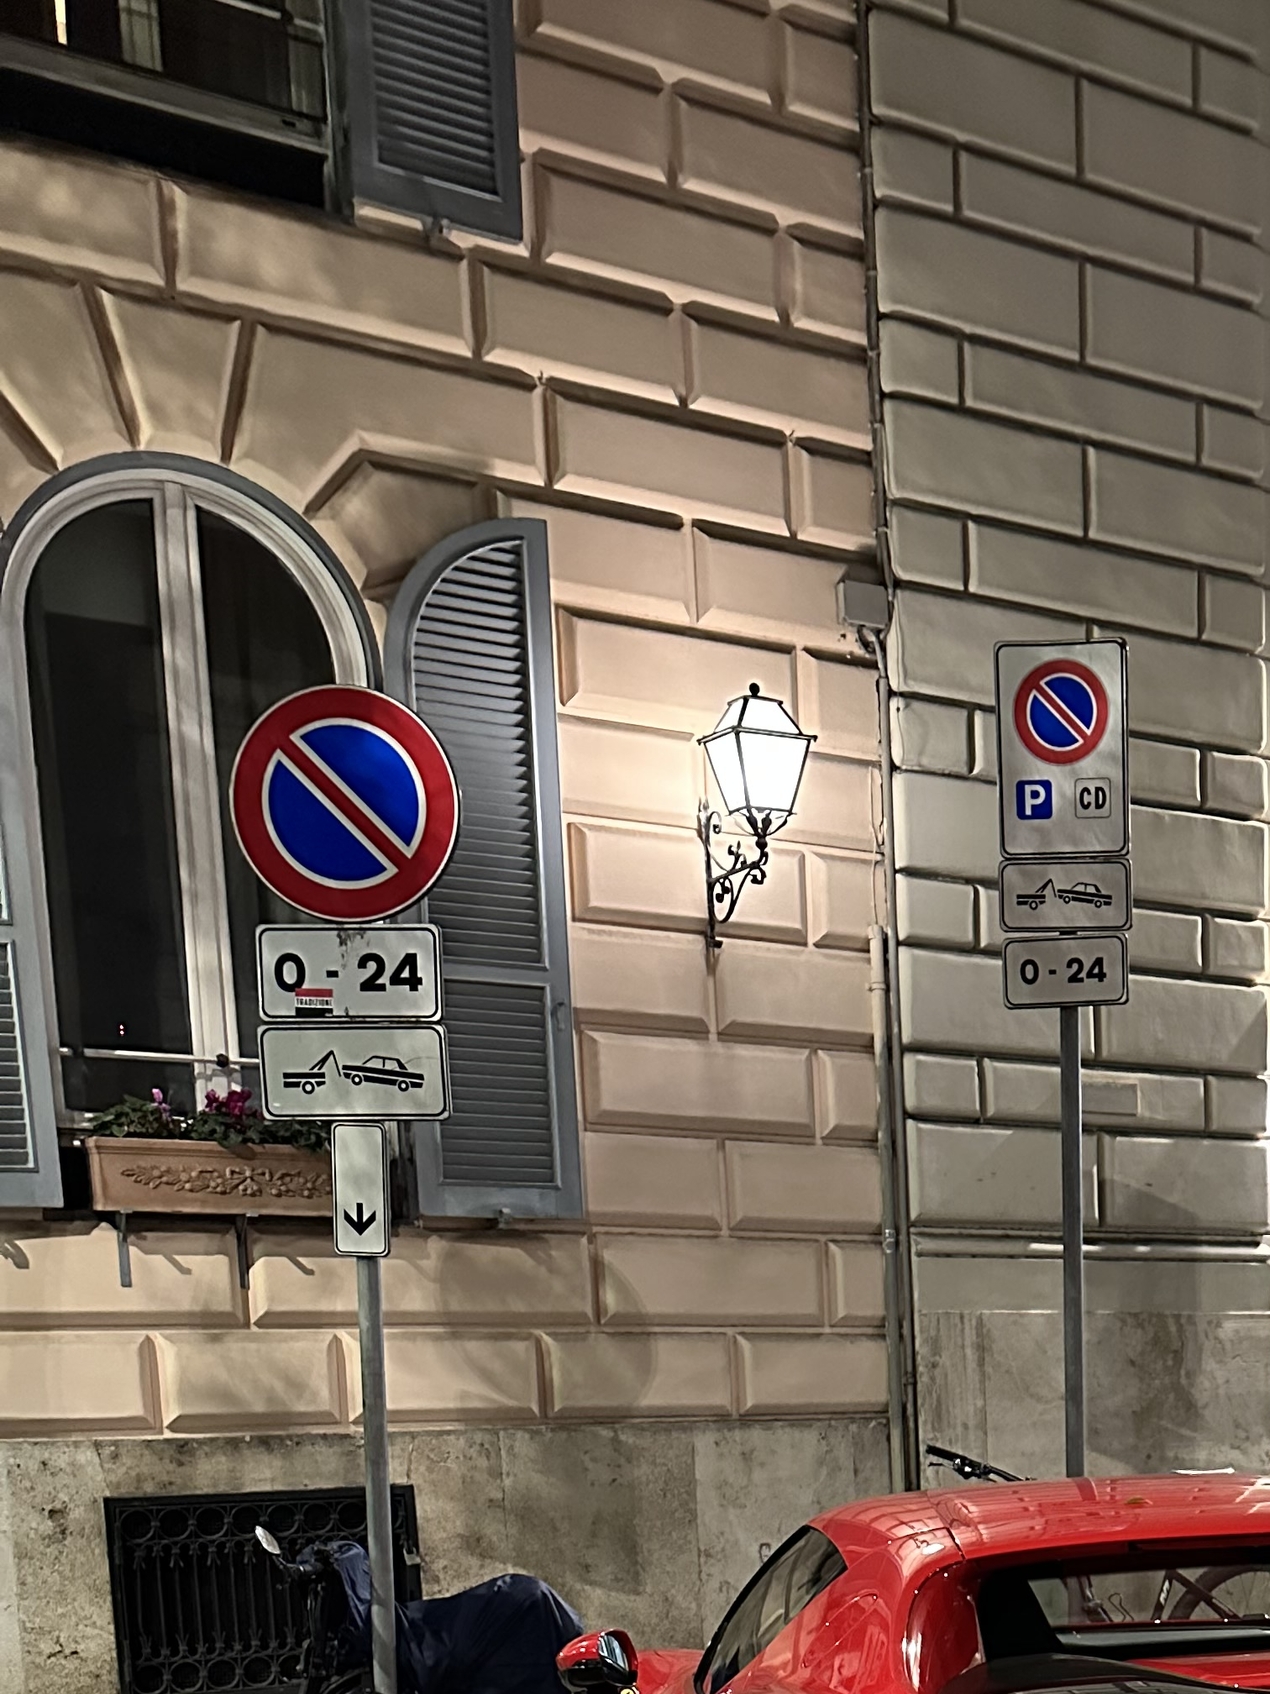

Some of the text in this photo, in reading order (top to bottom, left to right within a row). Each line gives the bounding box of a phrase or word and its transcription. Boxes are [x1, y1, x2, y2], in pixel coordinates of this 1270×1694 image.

[1024, 784, 1046, 816] P
[1079, 786, 1107, 811] CD
[274, 952, 306, 993] 0
[357, 952, 423, 992] 24
[1020, 958, 1039, 986] 0
[1066, 957, 1107, 983] 24
